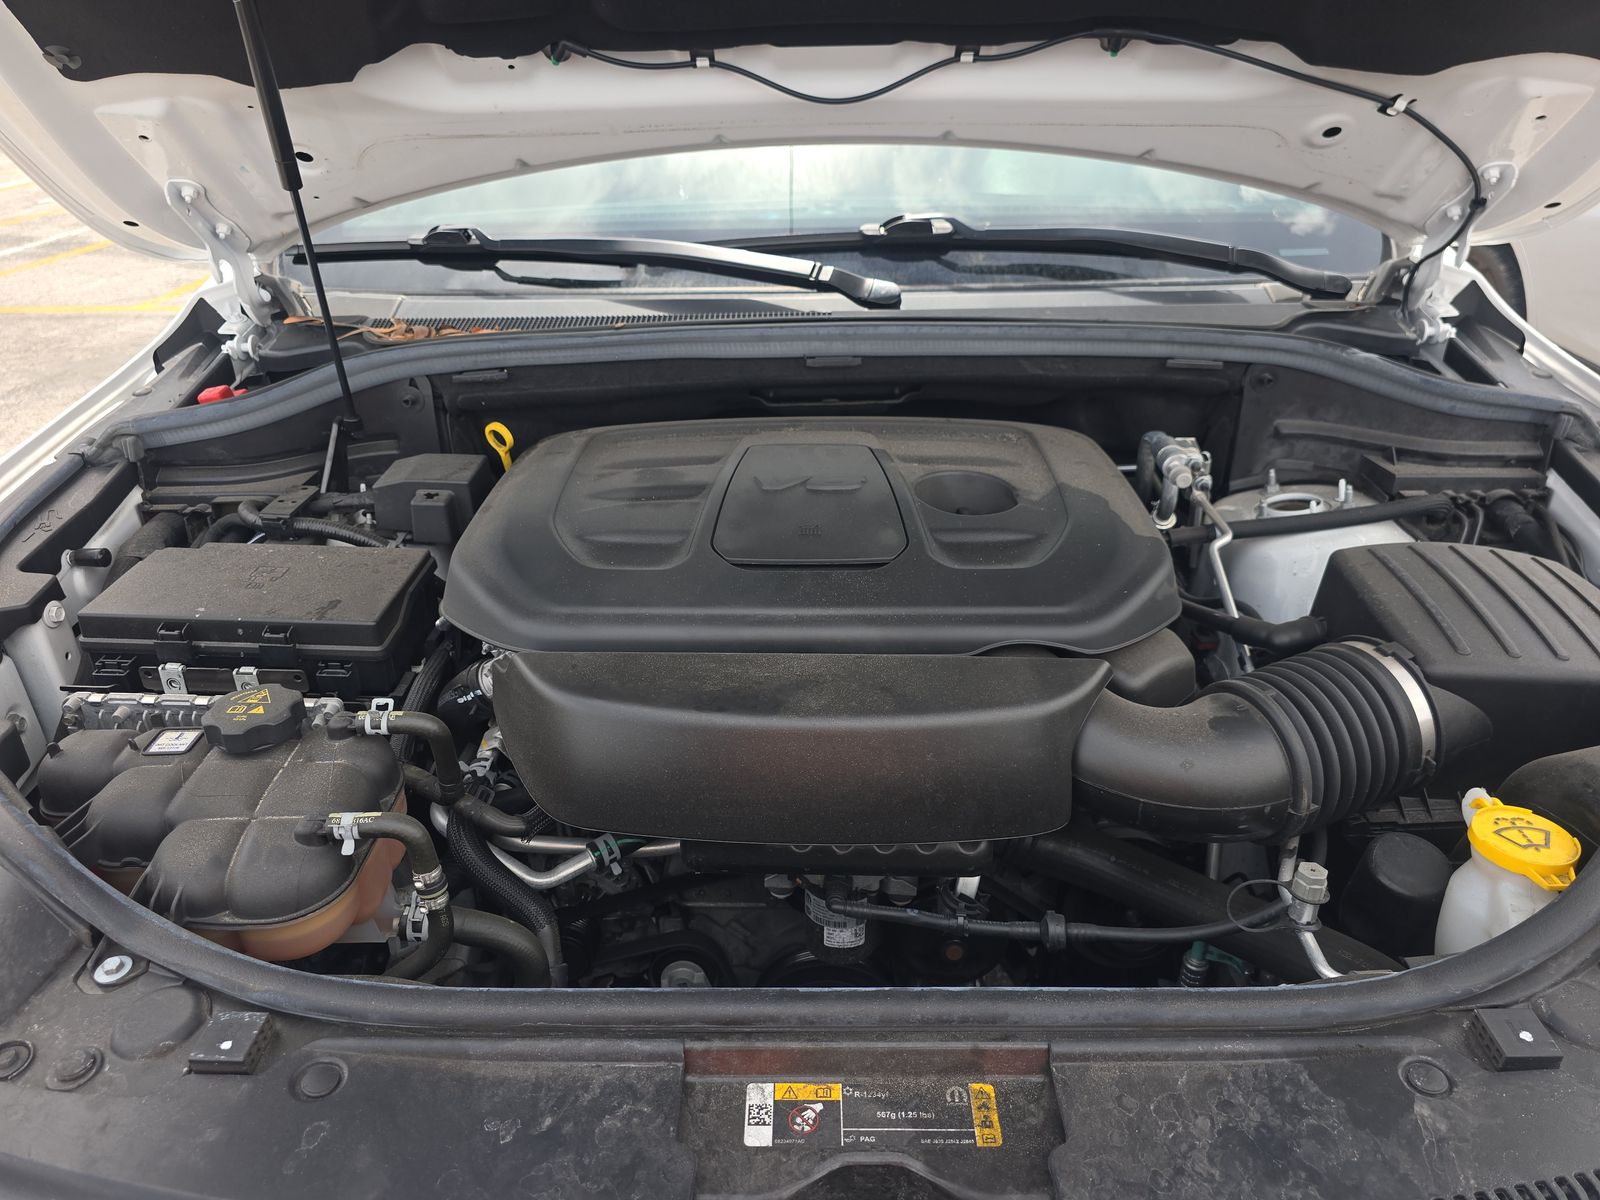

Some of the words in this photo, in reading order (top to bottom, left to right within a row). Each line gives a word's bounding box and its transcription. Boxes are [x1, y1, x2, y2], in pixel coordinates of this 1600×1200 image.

[331, 816, 375, 824] 68316AC
[876, 1111, 896, 1119] 567g
[898, 1111, 918, 1119] (1.25
